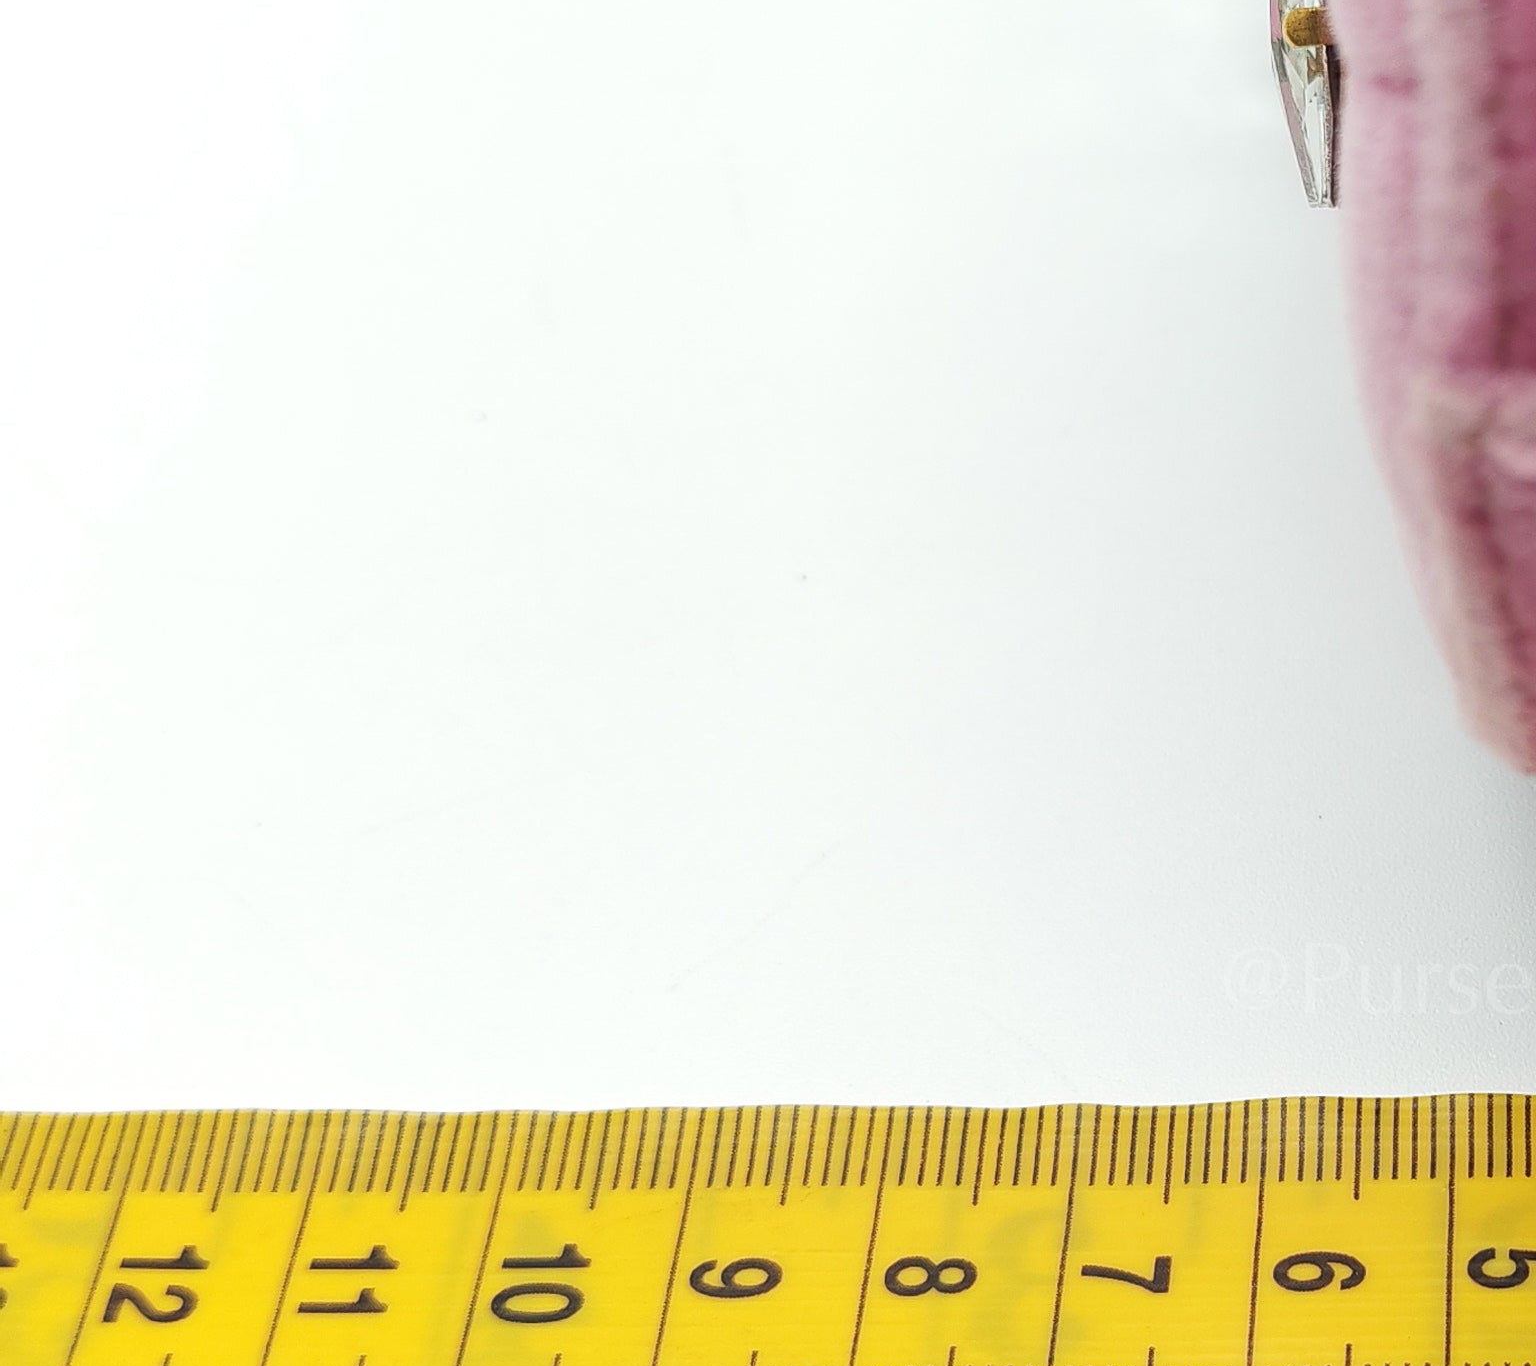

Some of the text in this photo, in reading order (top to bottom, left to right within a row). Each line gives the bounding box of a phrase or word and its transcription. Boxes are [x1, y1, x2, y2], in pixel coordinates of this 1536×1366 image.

[102, 1244, 211, 1324] 12
[295, 1244, 398, 1316] 11
[488, 1244, 590, 1326] 10
[687, 1257, 784, 1300] 9
[882, 1256, 979, 1299] 8
[1079, 1255, 1173, 1296] 7
[1271, 1249, 1368, 1294] 6
